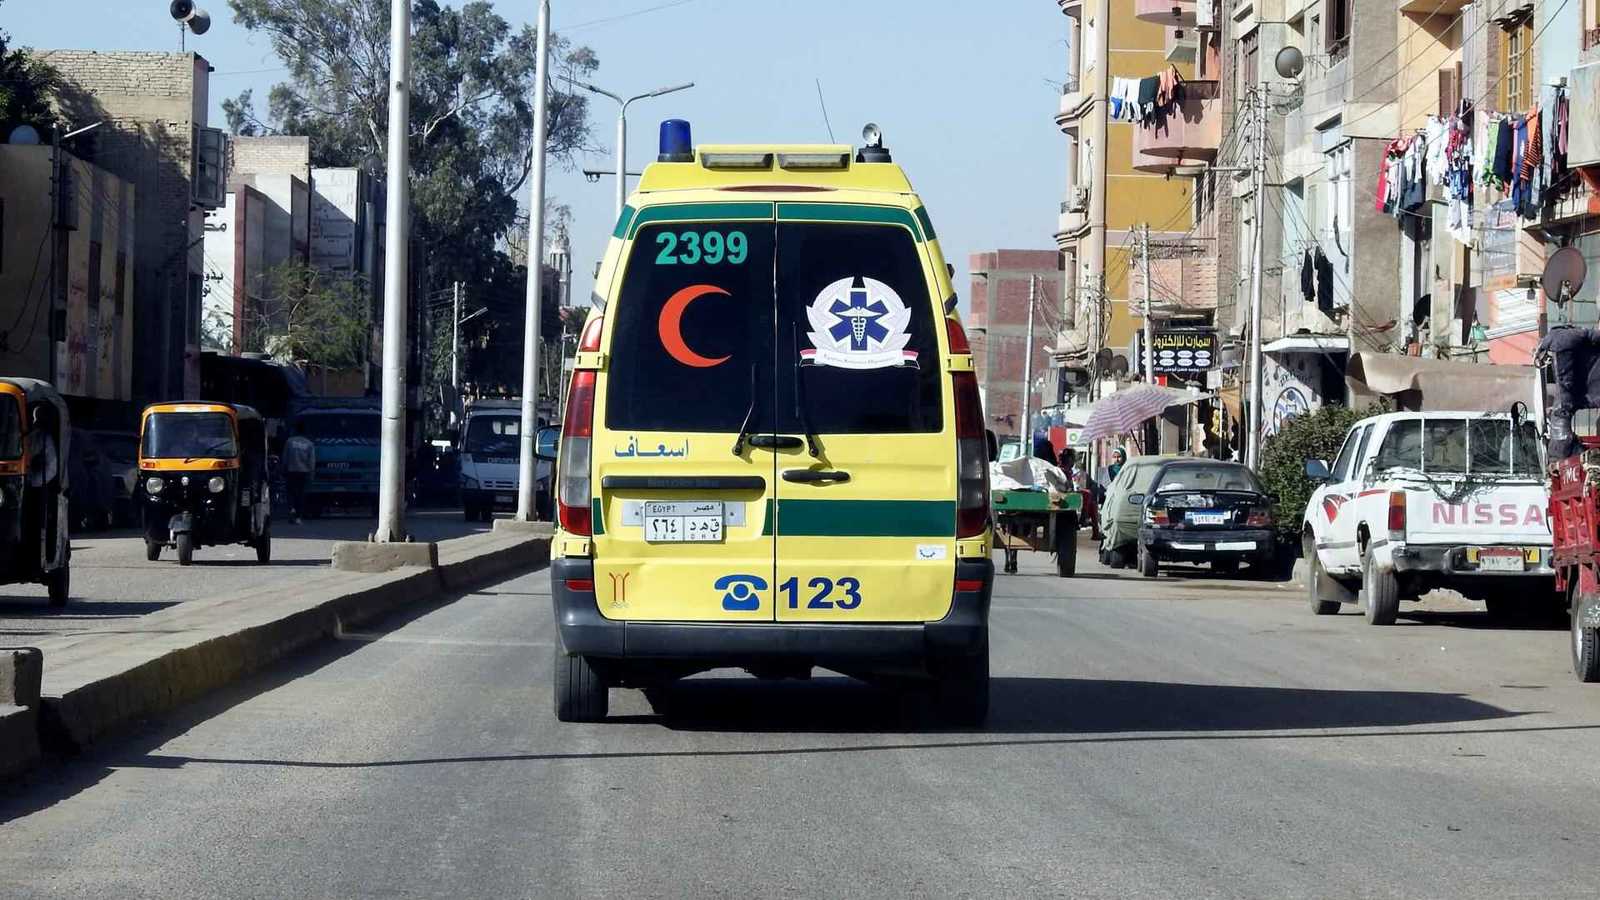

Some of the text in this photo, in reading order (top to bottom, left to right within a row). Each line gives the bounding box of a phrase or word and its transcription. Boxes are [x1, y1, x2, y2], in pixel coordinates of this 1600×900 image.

[655, 231, 748, 264] 2399
[652, 505, 676, 513] EGYPT
[693, 504, 714, 512] مصر
[1432, 502, 1545, 526] NISSA
[779, 577, 862, 610] 123
